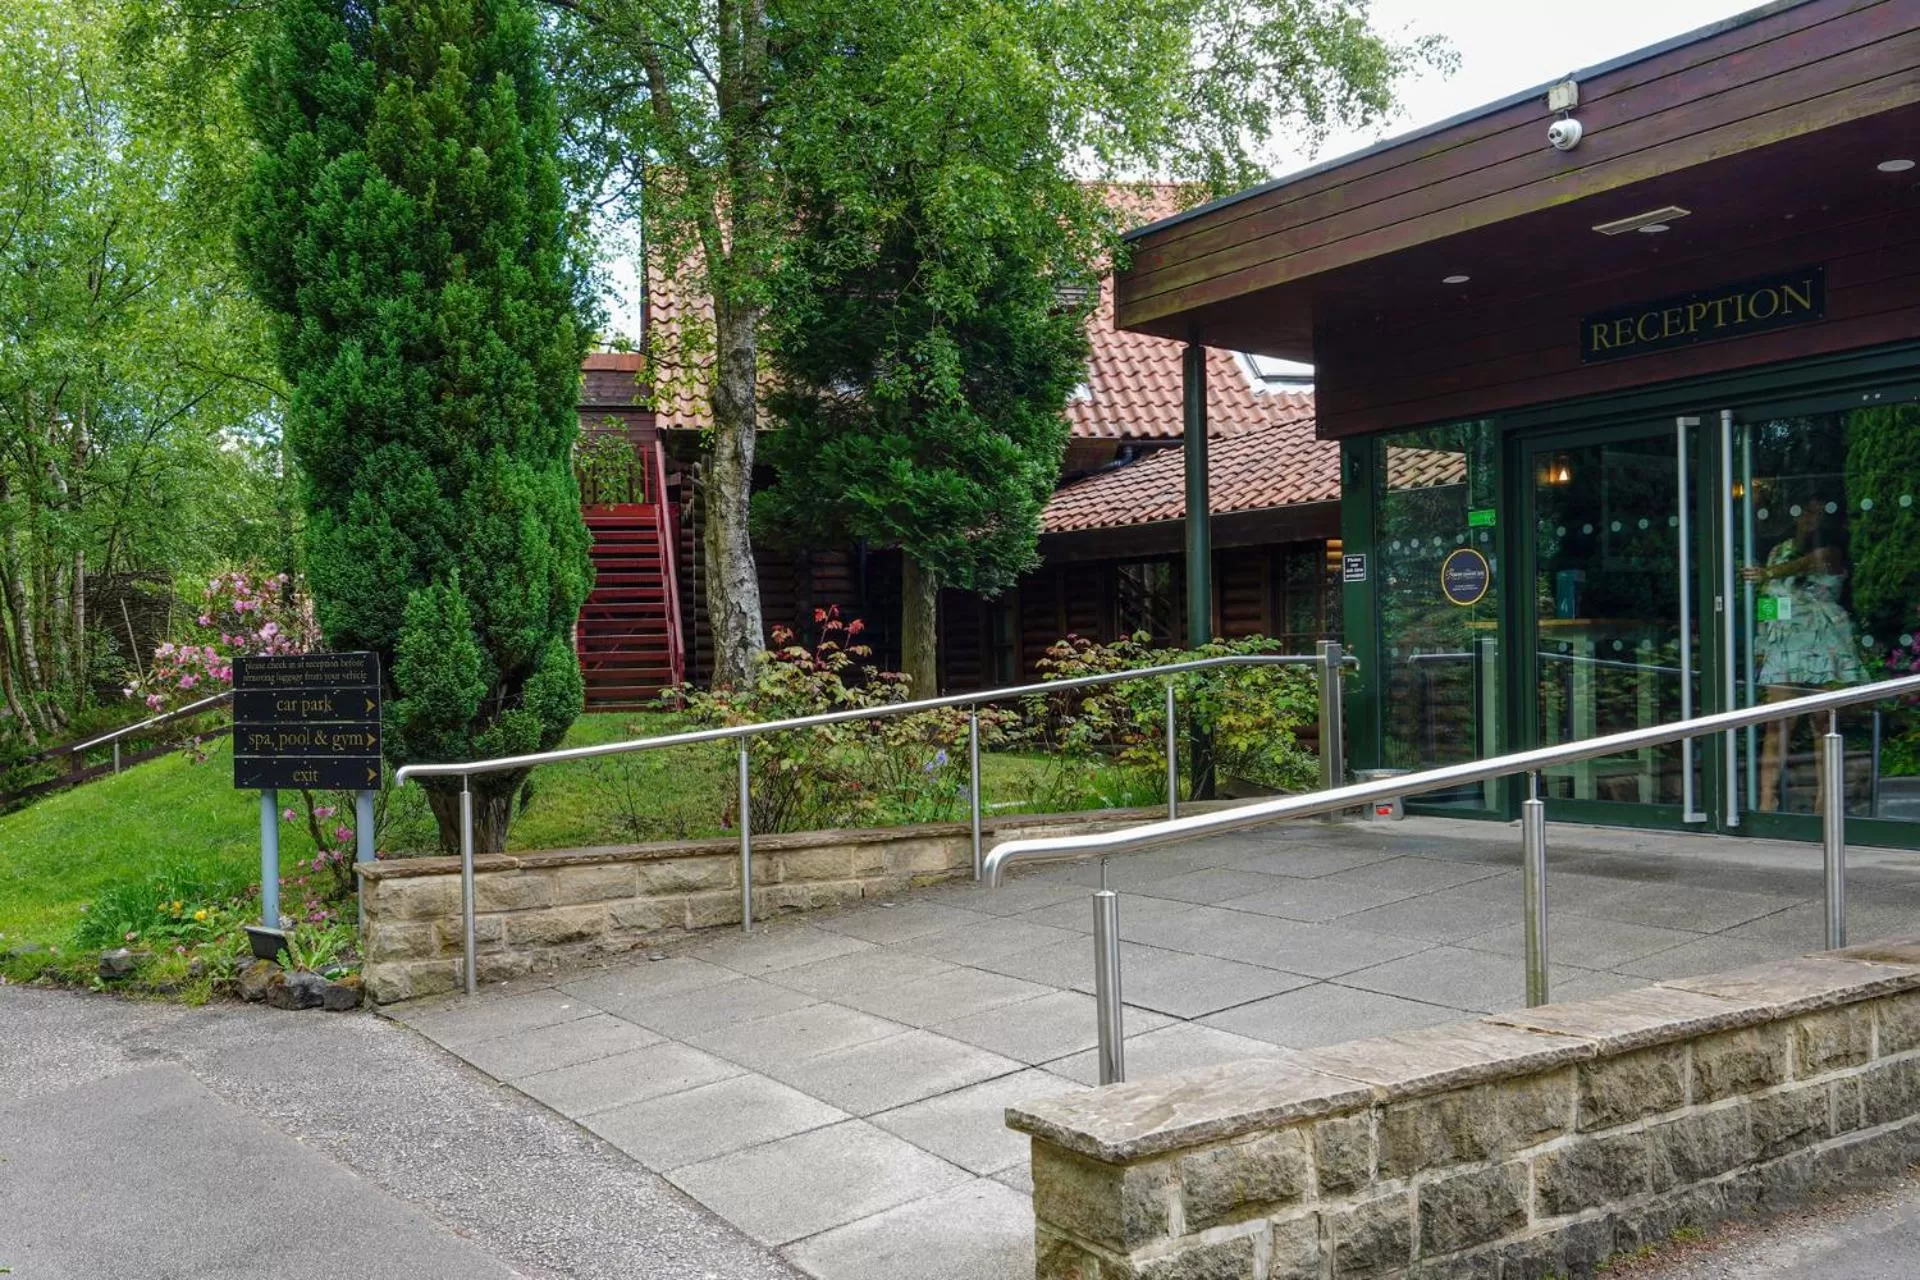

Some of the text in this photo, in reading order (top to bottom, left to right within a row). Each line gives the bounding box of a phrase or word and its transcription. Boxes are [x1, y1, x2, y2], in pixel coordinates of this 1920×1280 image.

[1591, 279, 1813, 351] RECEPTION
[277, 694, 333, 717] car park
[249, 729, 364, 751] spa, pool & gym
[292, 764, 319, 782] exit
